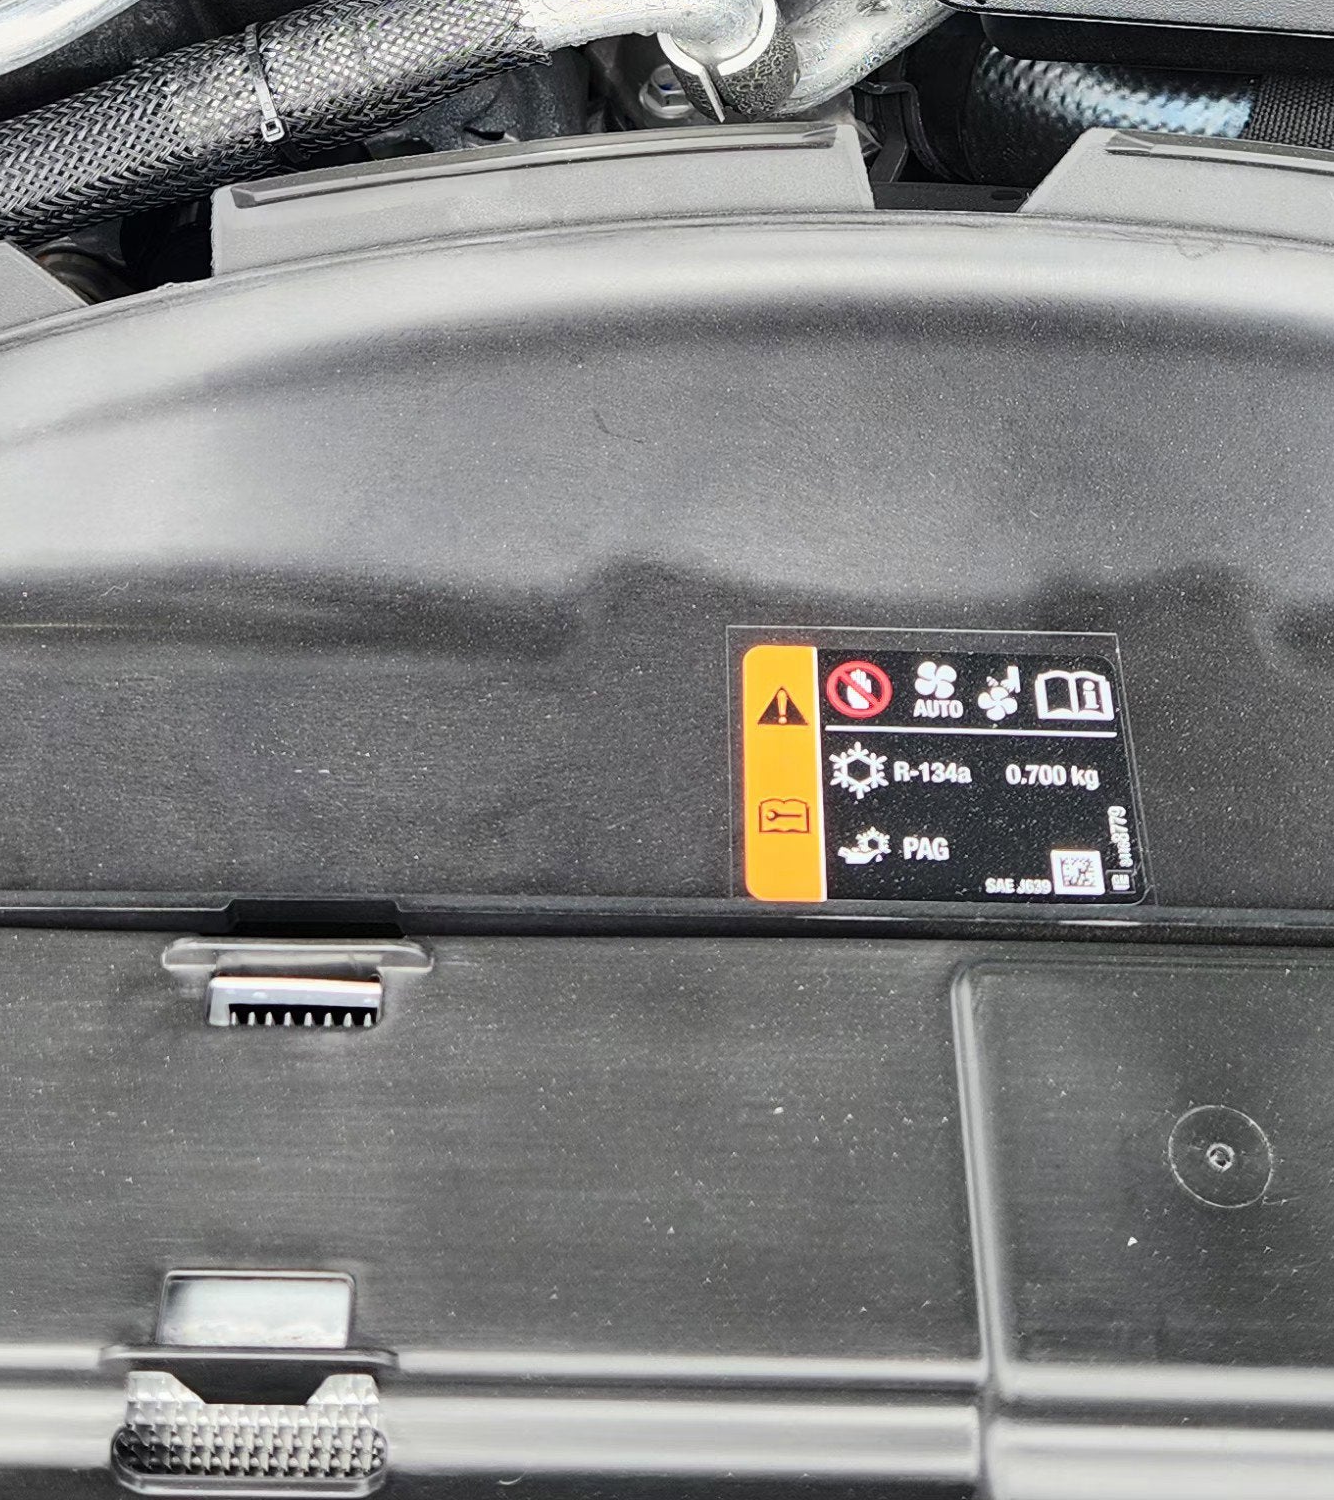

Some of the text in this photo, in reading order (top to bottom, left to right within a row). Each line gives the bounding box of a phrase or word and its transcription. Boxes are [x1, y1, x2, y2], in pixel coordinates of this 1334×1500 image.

[914, 699, 964, 718] AUTO
[893, 761, 1099, 790] R-134a 0.700 kg
[903, 837, 950, 861] PAG
[985, 877, 1052, 895] SAE J639
